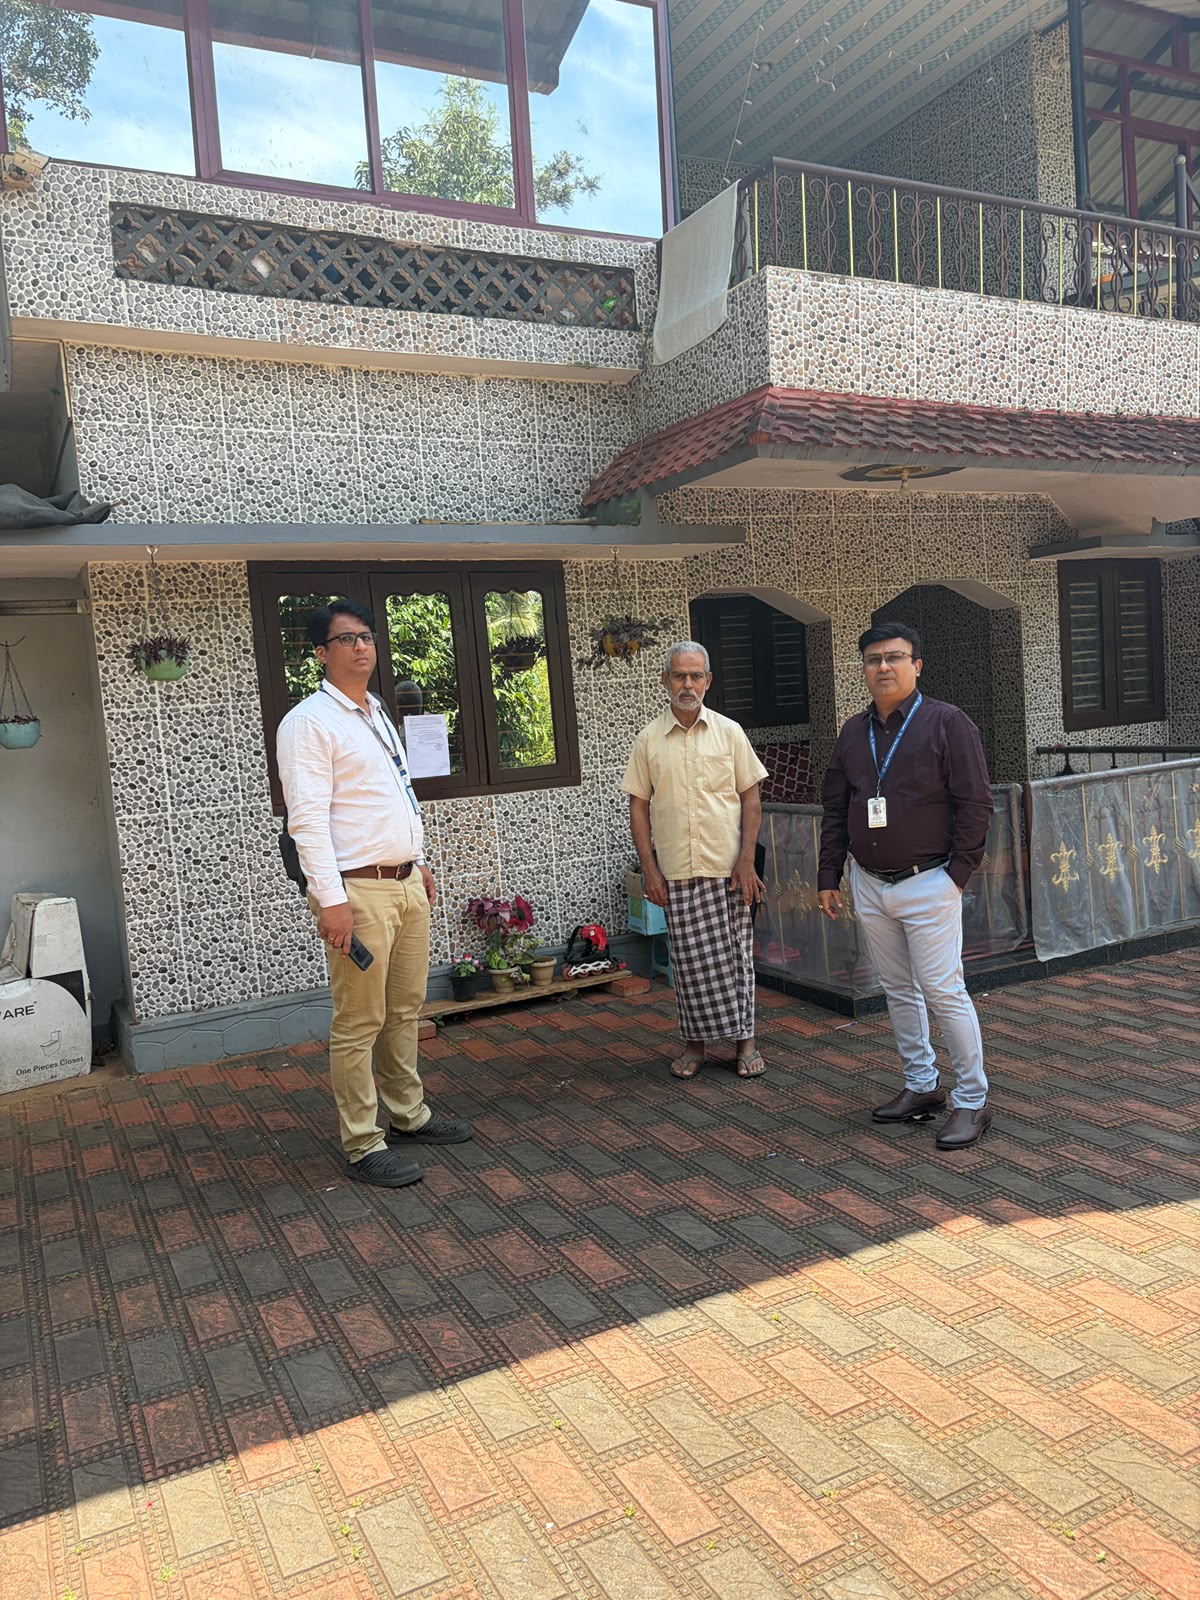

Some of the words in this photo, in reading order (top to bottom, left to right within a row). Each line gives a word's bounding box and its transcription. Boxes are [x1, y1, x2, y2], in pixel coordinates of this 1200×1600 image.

[0, 1004, 35, 1020] ARE
[16, 1068, 31, 1076] One
[33, 1063, 58, 1072] Pieces
[60, 1056, 83, 1067] Closet
